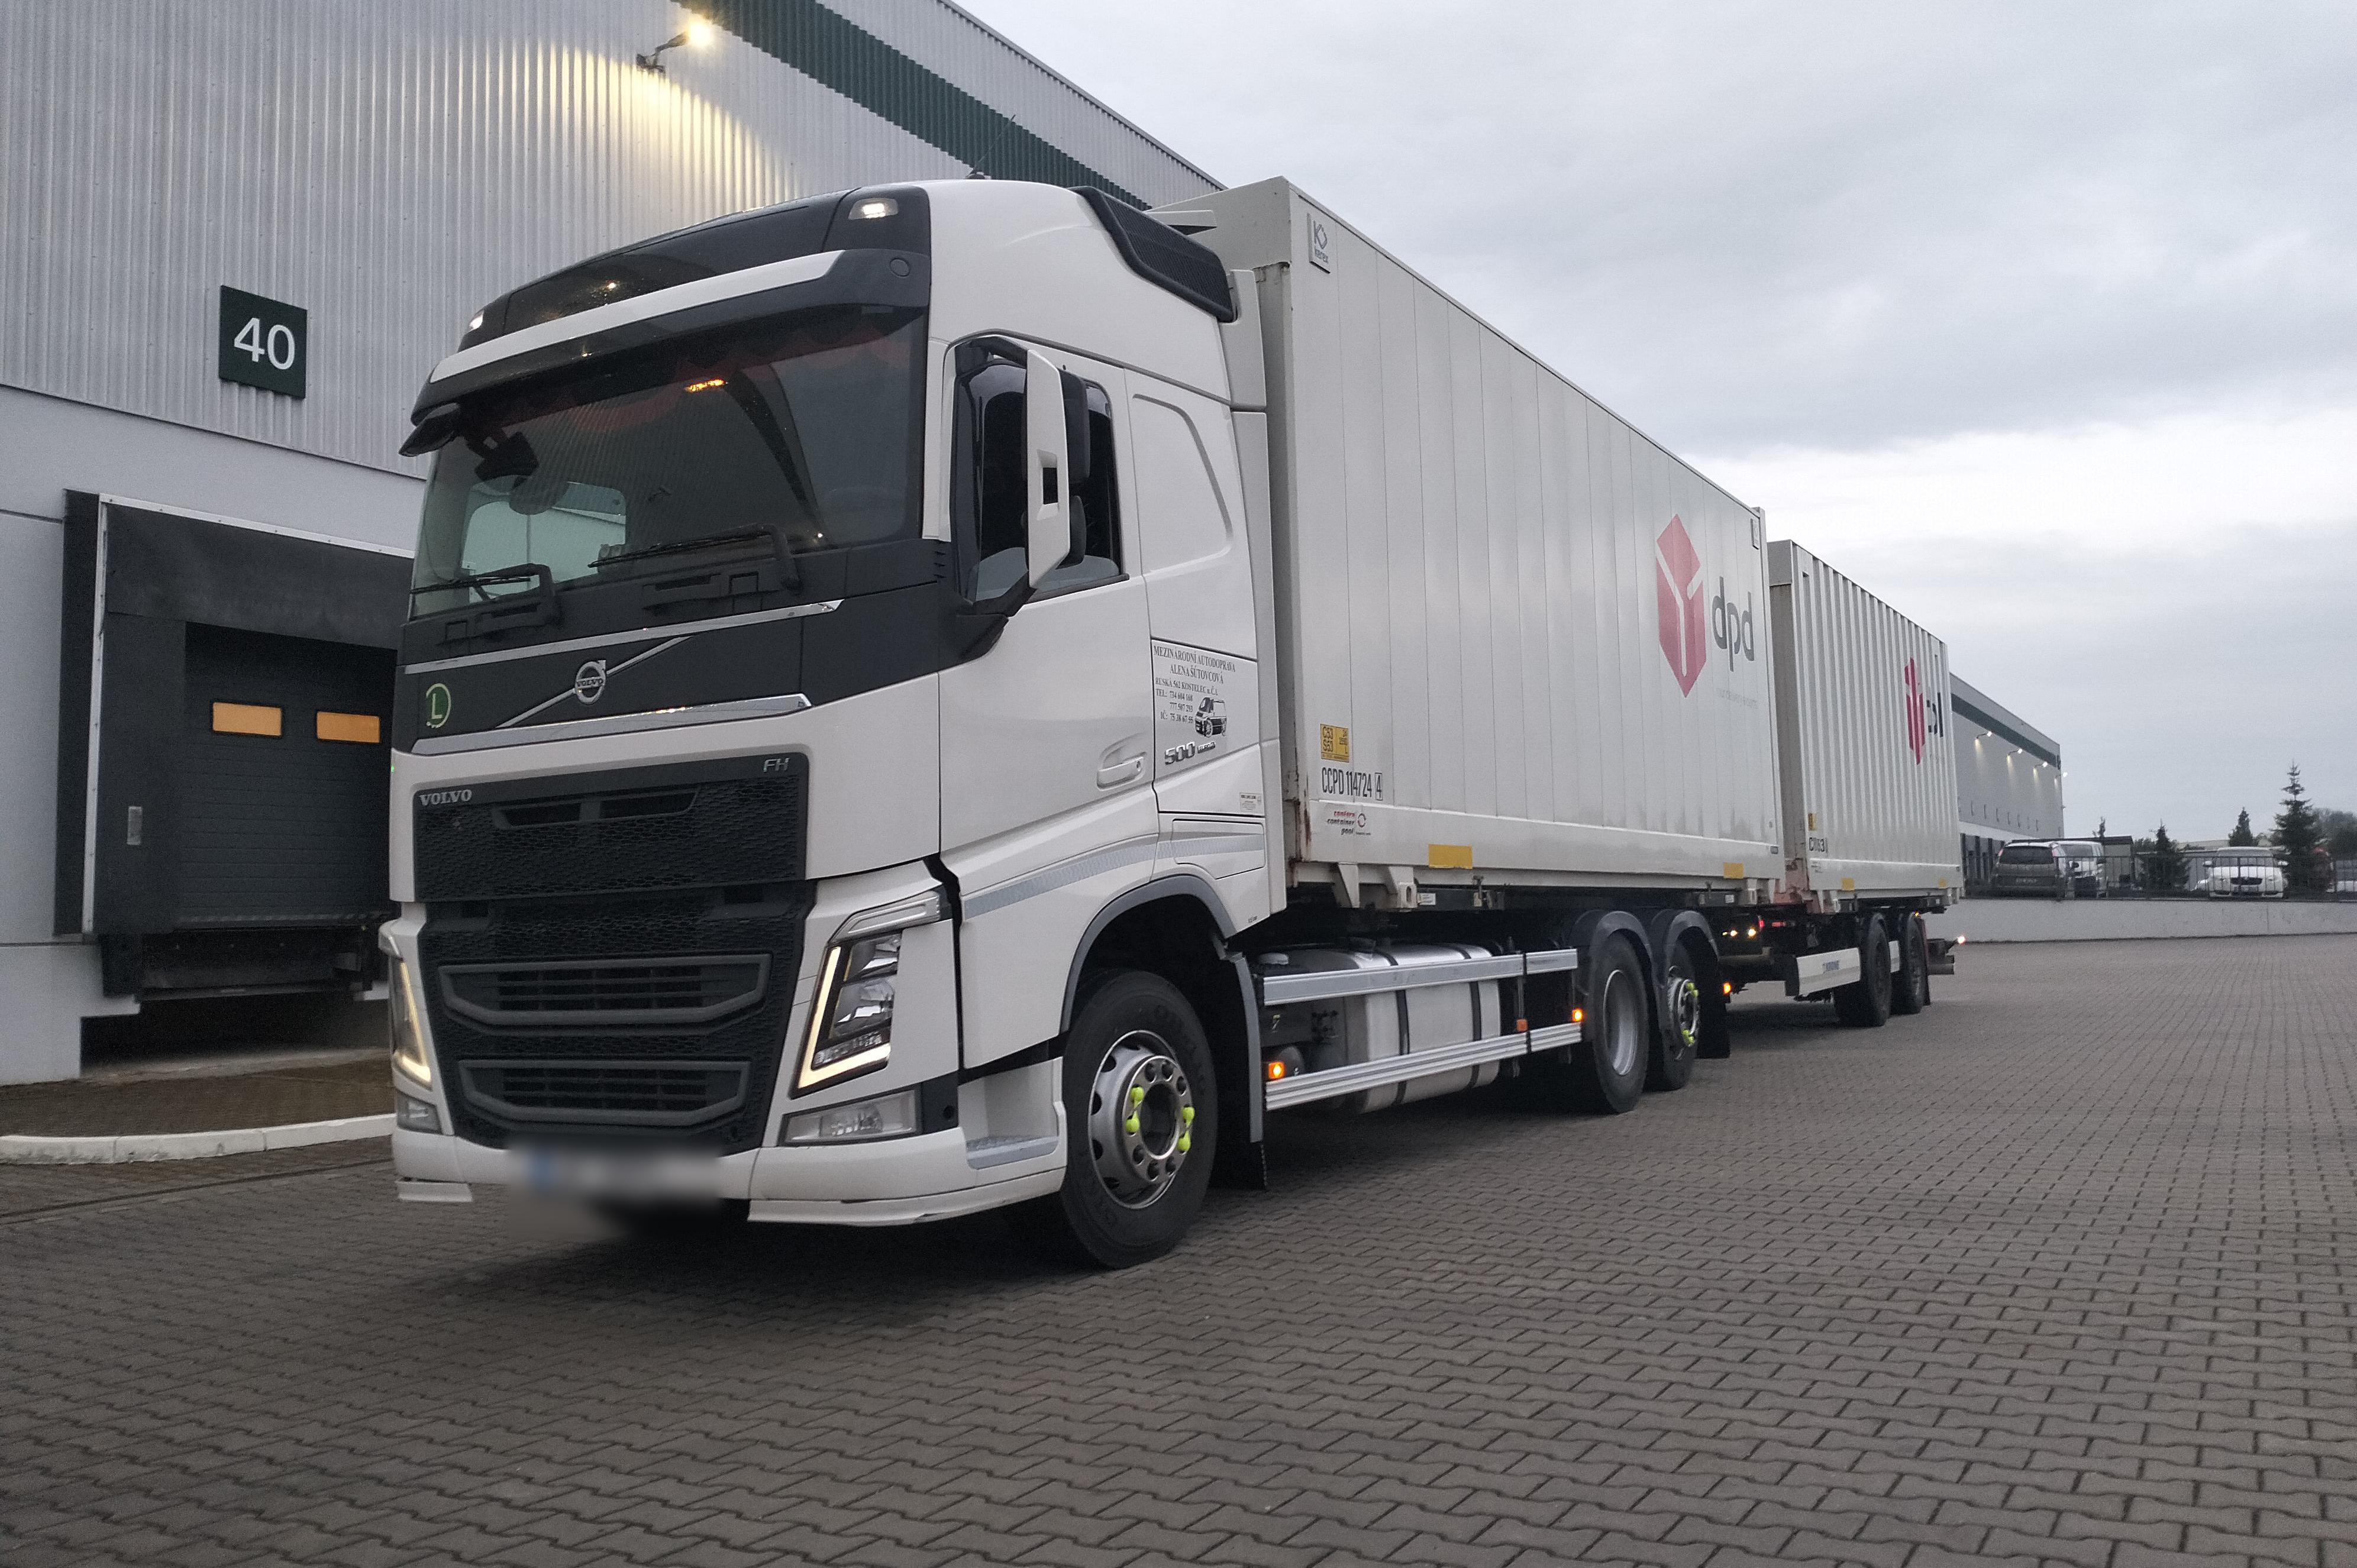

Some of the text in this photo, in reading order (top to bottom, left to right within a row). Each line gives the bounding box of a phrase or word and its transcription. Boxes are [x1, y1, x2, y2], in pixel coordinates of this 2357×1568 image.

[234, 317, 295, 370] 40
[1712, 576, 1755, 672] dpd
[763, 758, 790, 772] FH
[1165, 742, 1195, 764] 500
[1322, 767, 1344, 795] CCPD
[1345, 771, 1372, 798] 114724
[419, 789, 472, 806] VOLVO
